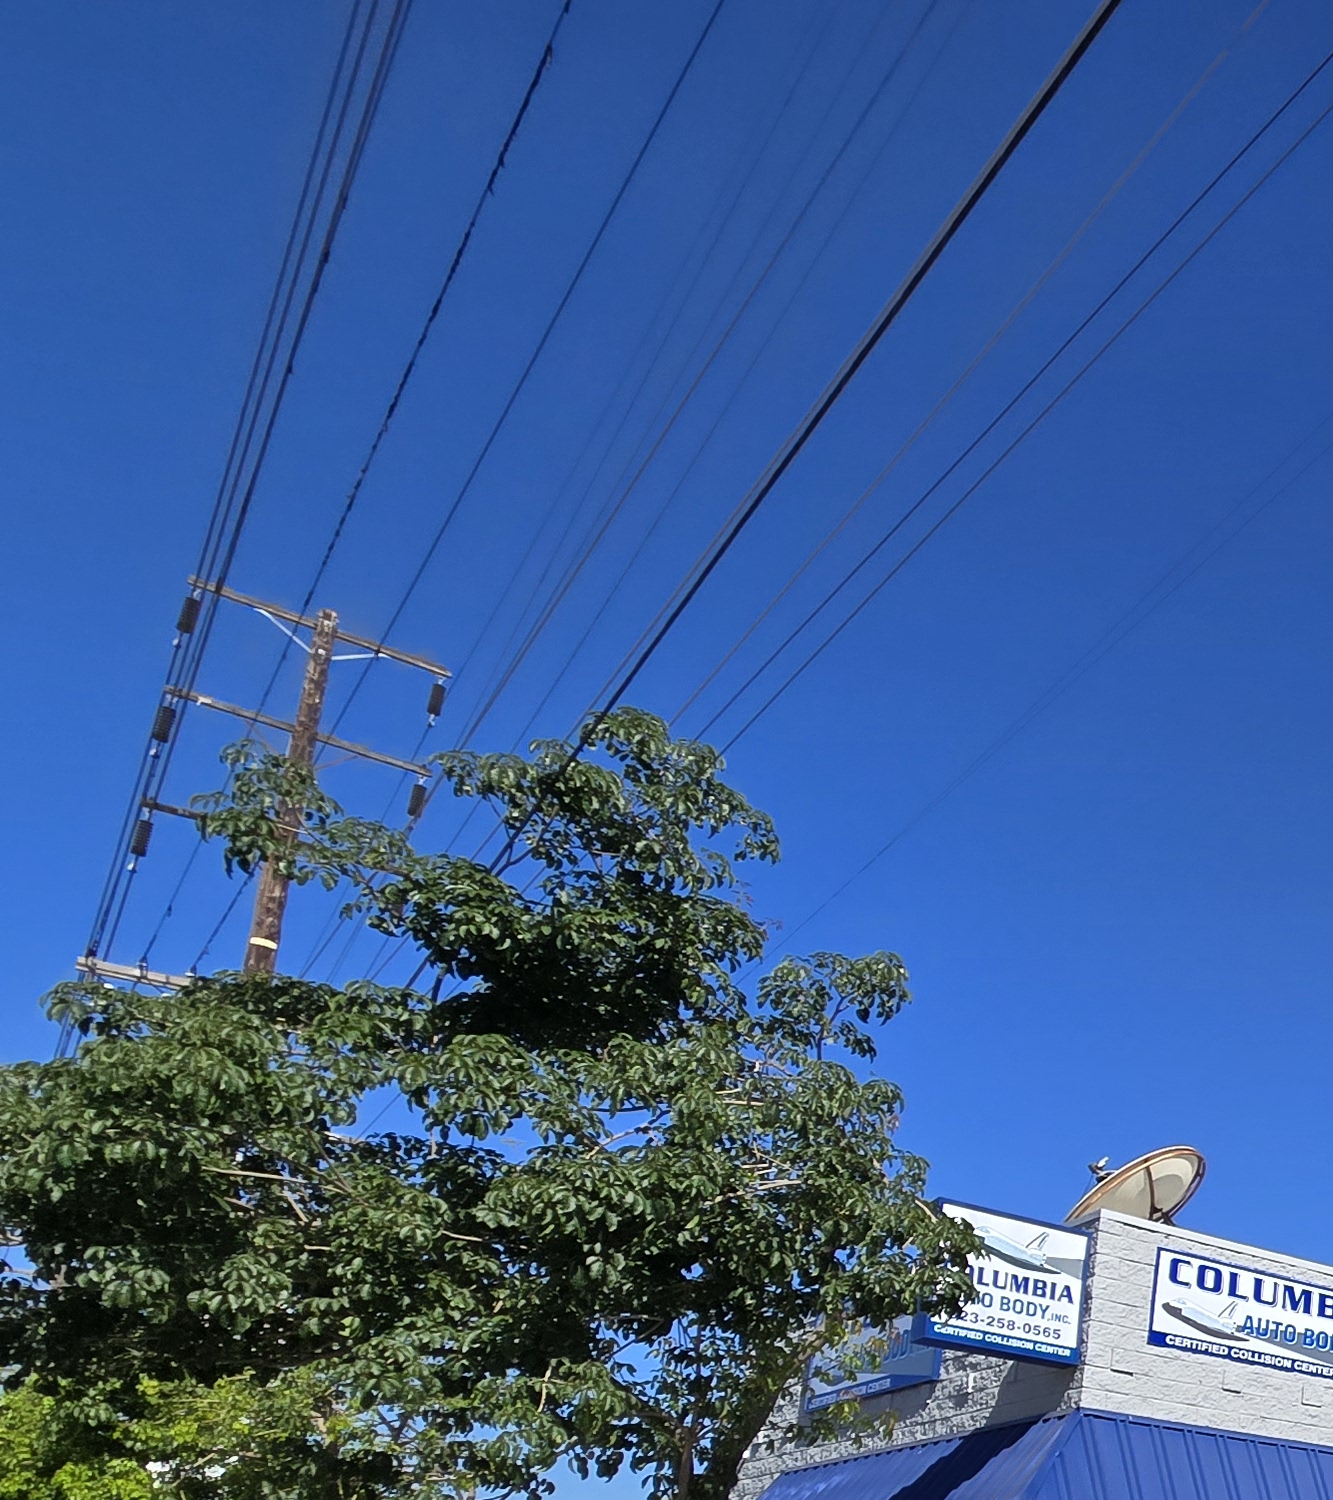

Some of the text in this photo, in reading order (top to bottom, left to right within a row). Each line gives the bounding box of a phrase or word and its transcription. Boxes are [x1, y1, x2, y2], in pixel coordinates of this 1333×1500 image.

[968, 1265, 1074, 1305] LUMBIA
[957, 1311, 1061, 1340] 23-258-0565
[1241, 1315, 1298, 1344] AUTO
[985, 1334, 1034, 1350] COLLISION
[1035, 1343, 1071, 1357] CENTER
[1165, 1334, 1228, 1356] CERTIFIED
[1230, 1348, 1293, 1369] COLLISION
